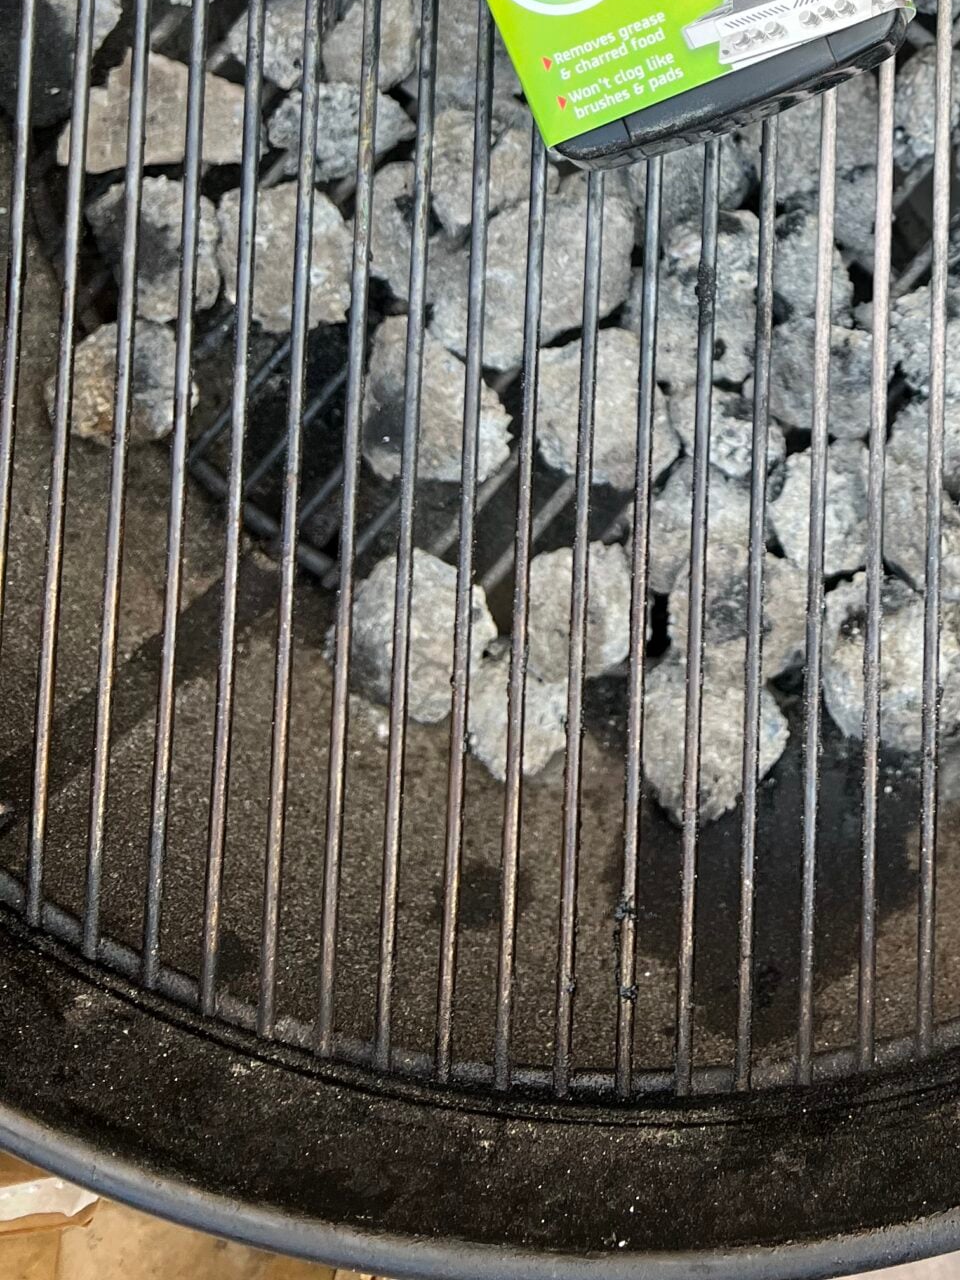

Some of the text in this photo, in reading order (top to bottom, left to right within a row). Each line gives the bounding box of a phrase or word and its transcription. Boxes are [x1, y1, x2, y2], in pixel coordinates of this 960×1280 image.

[553, 11, 666, 65] Removes grease
[560, 27, 666, 80] & charred food
[568, 52, 675, 103] Won't clog like
[573, 66, 684, 120] brushes & pads
